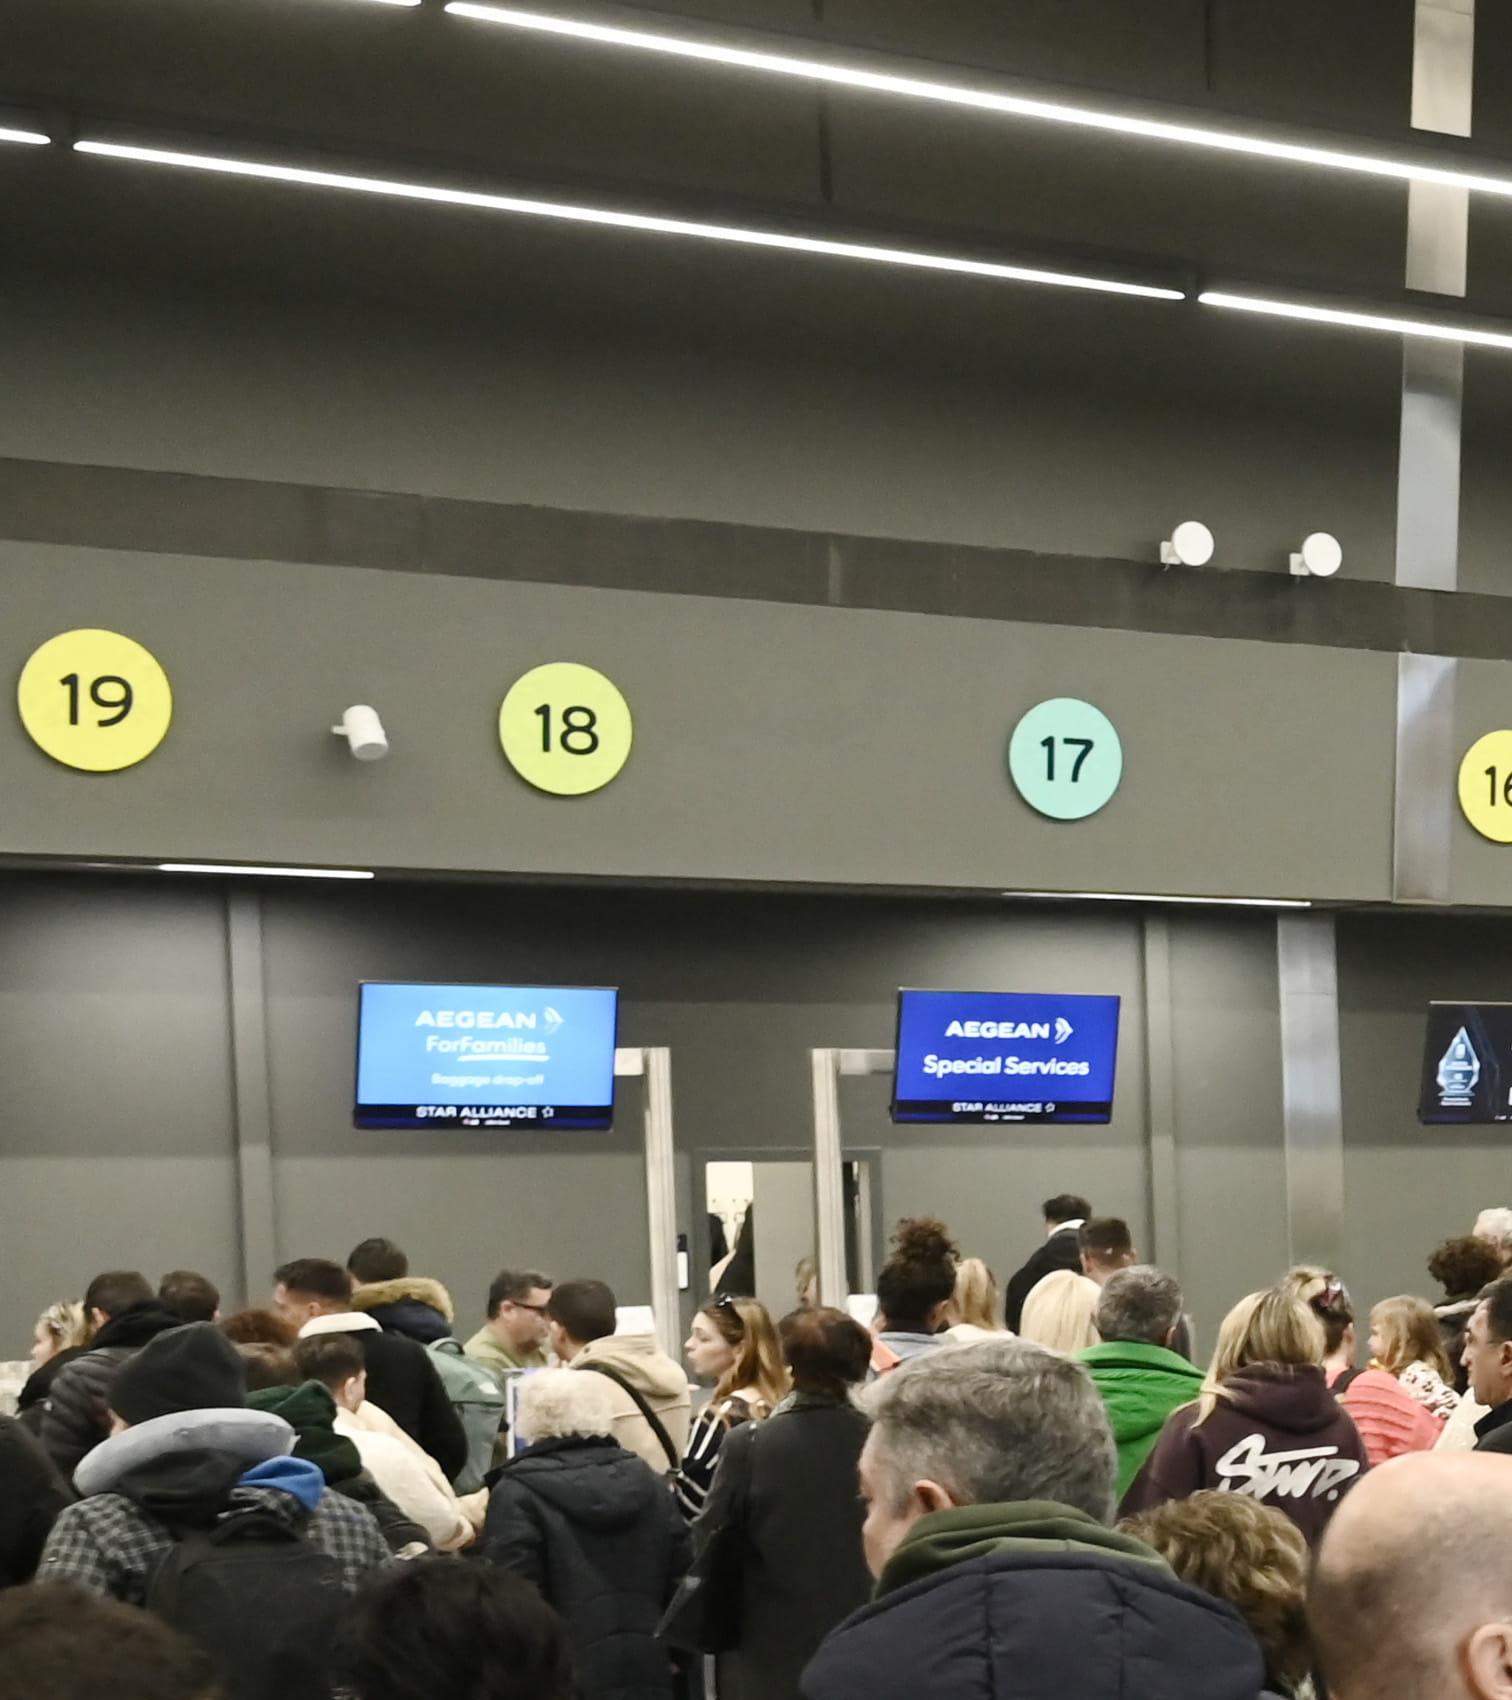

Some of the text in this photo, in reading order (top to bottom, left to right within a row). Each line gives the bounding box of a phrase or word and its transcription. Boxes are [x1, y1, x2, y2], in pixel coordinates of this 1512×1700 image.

[60, 673, 133, 727] 19
[533, 704, 599, 756] 18
[1040, 735, 1095, 783] 17
[415, 1010, 536, 1029] AEGEAN
[944, 1020, 1050, 1039] AEGEAN
[426, 1035, 547, 1054] ForFamilies
[922, 1054, 1090, 1078] Special Services
[416, 1106, 537, 1119] STAR ALLIANCE
[952, 1102, 983, 1113] STAR
